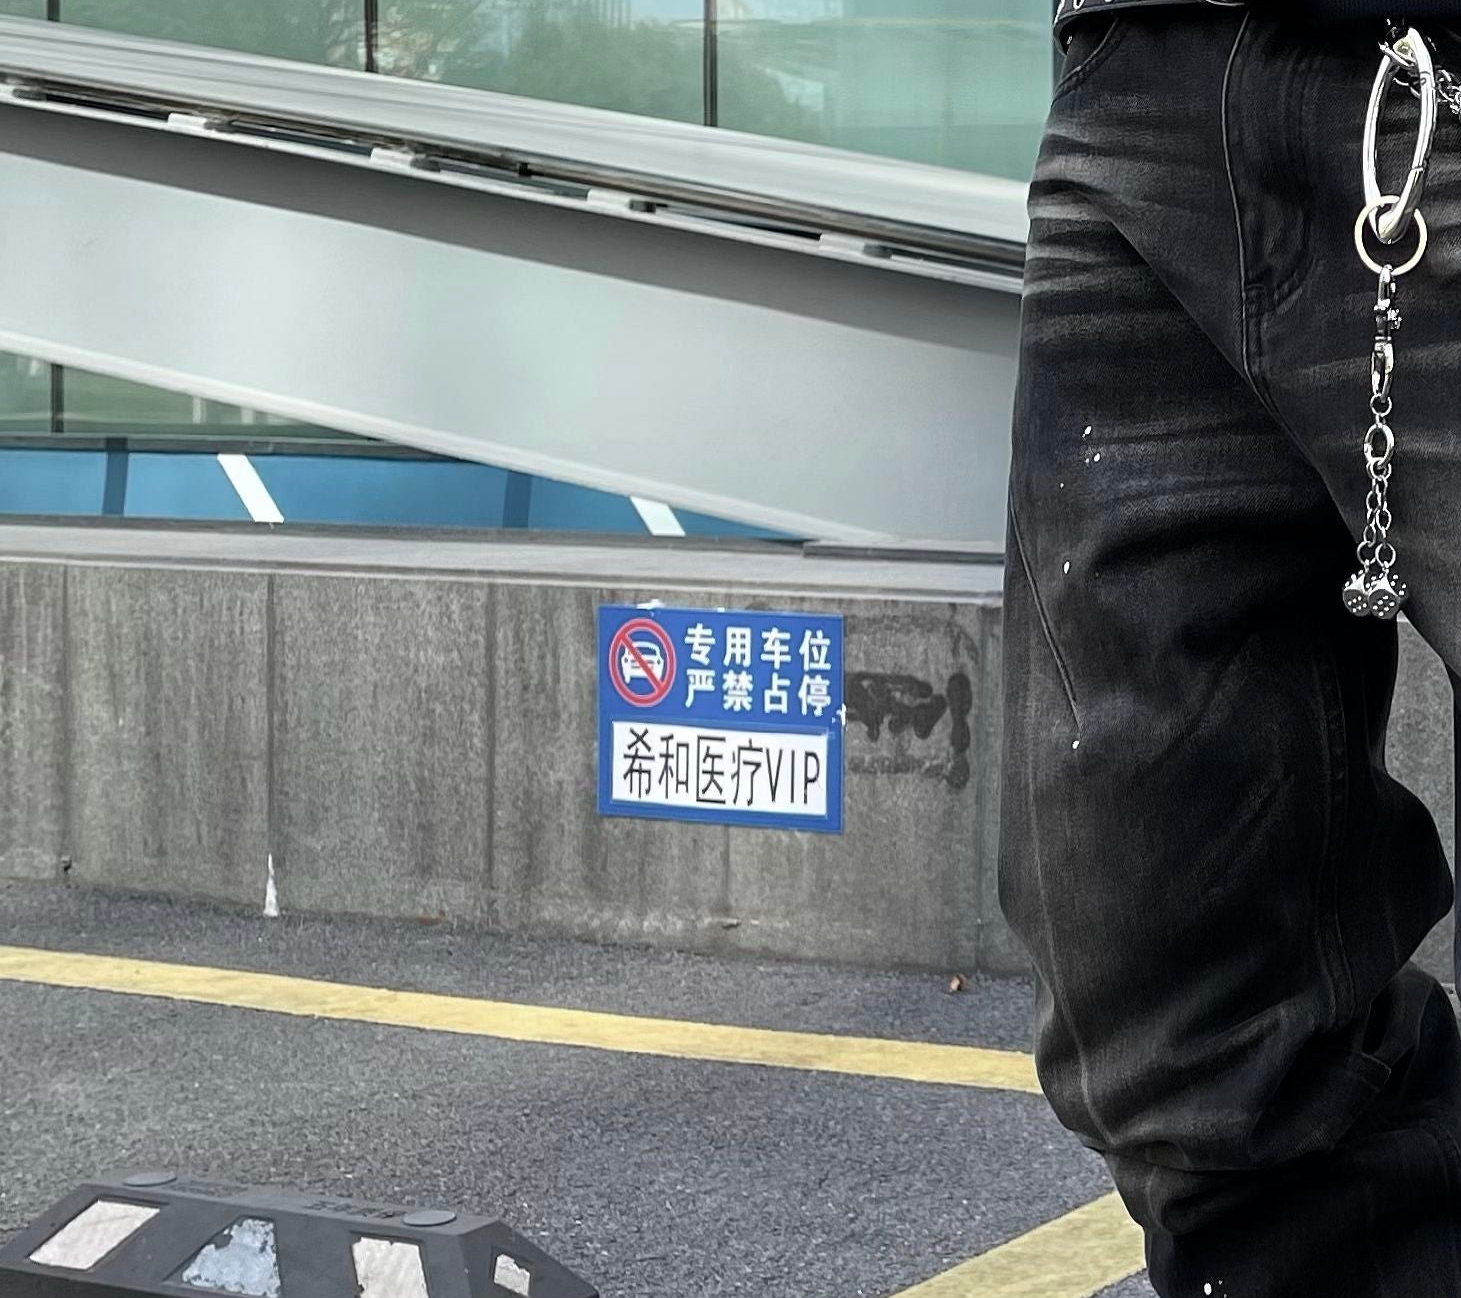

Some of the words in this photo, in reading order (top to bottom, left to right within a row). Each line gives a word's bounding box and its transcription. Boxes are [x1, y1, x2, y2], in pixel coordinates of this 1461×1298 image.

[684, 623, 832, 671] 专用车位
[684, 668, 832, 717] 严禁占停
[622, 727, 821, 807] 希和医疗VIP
